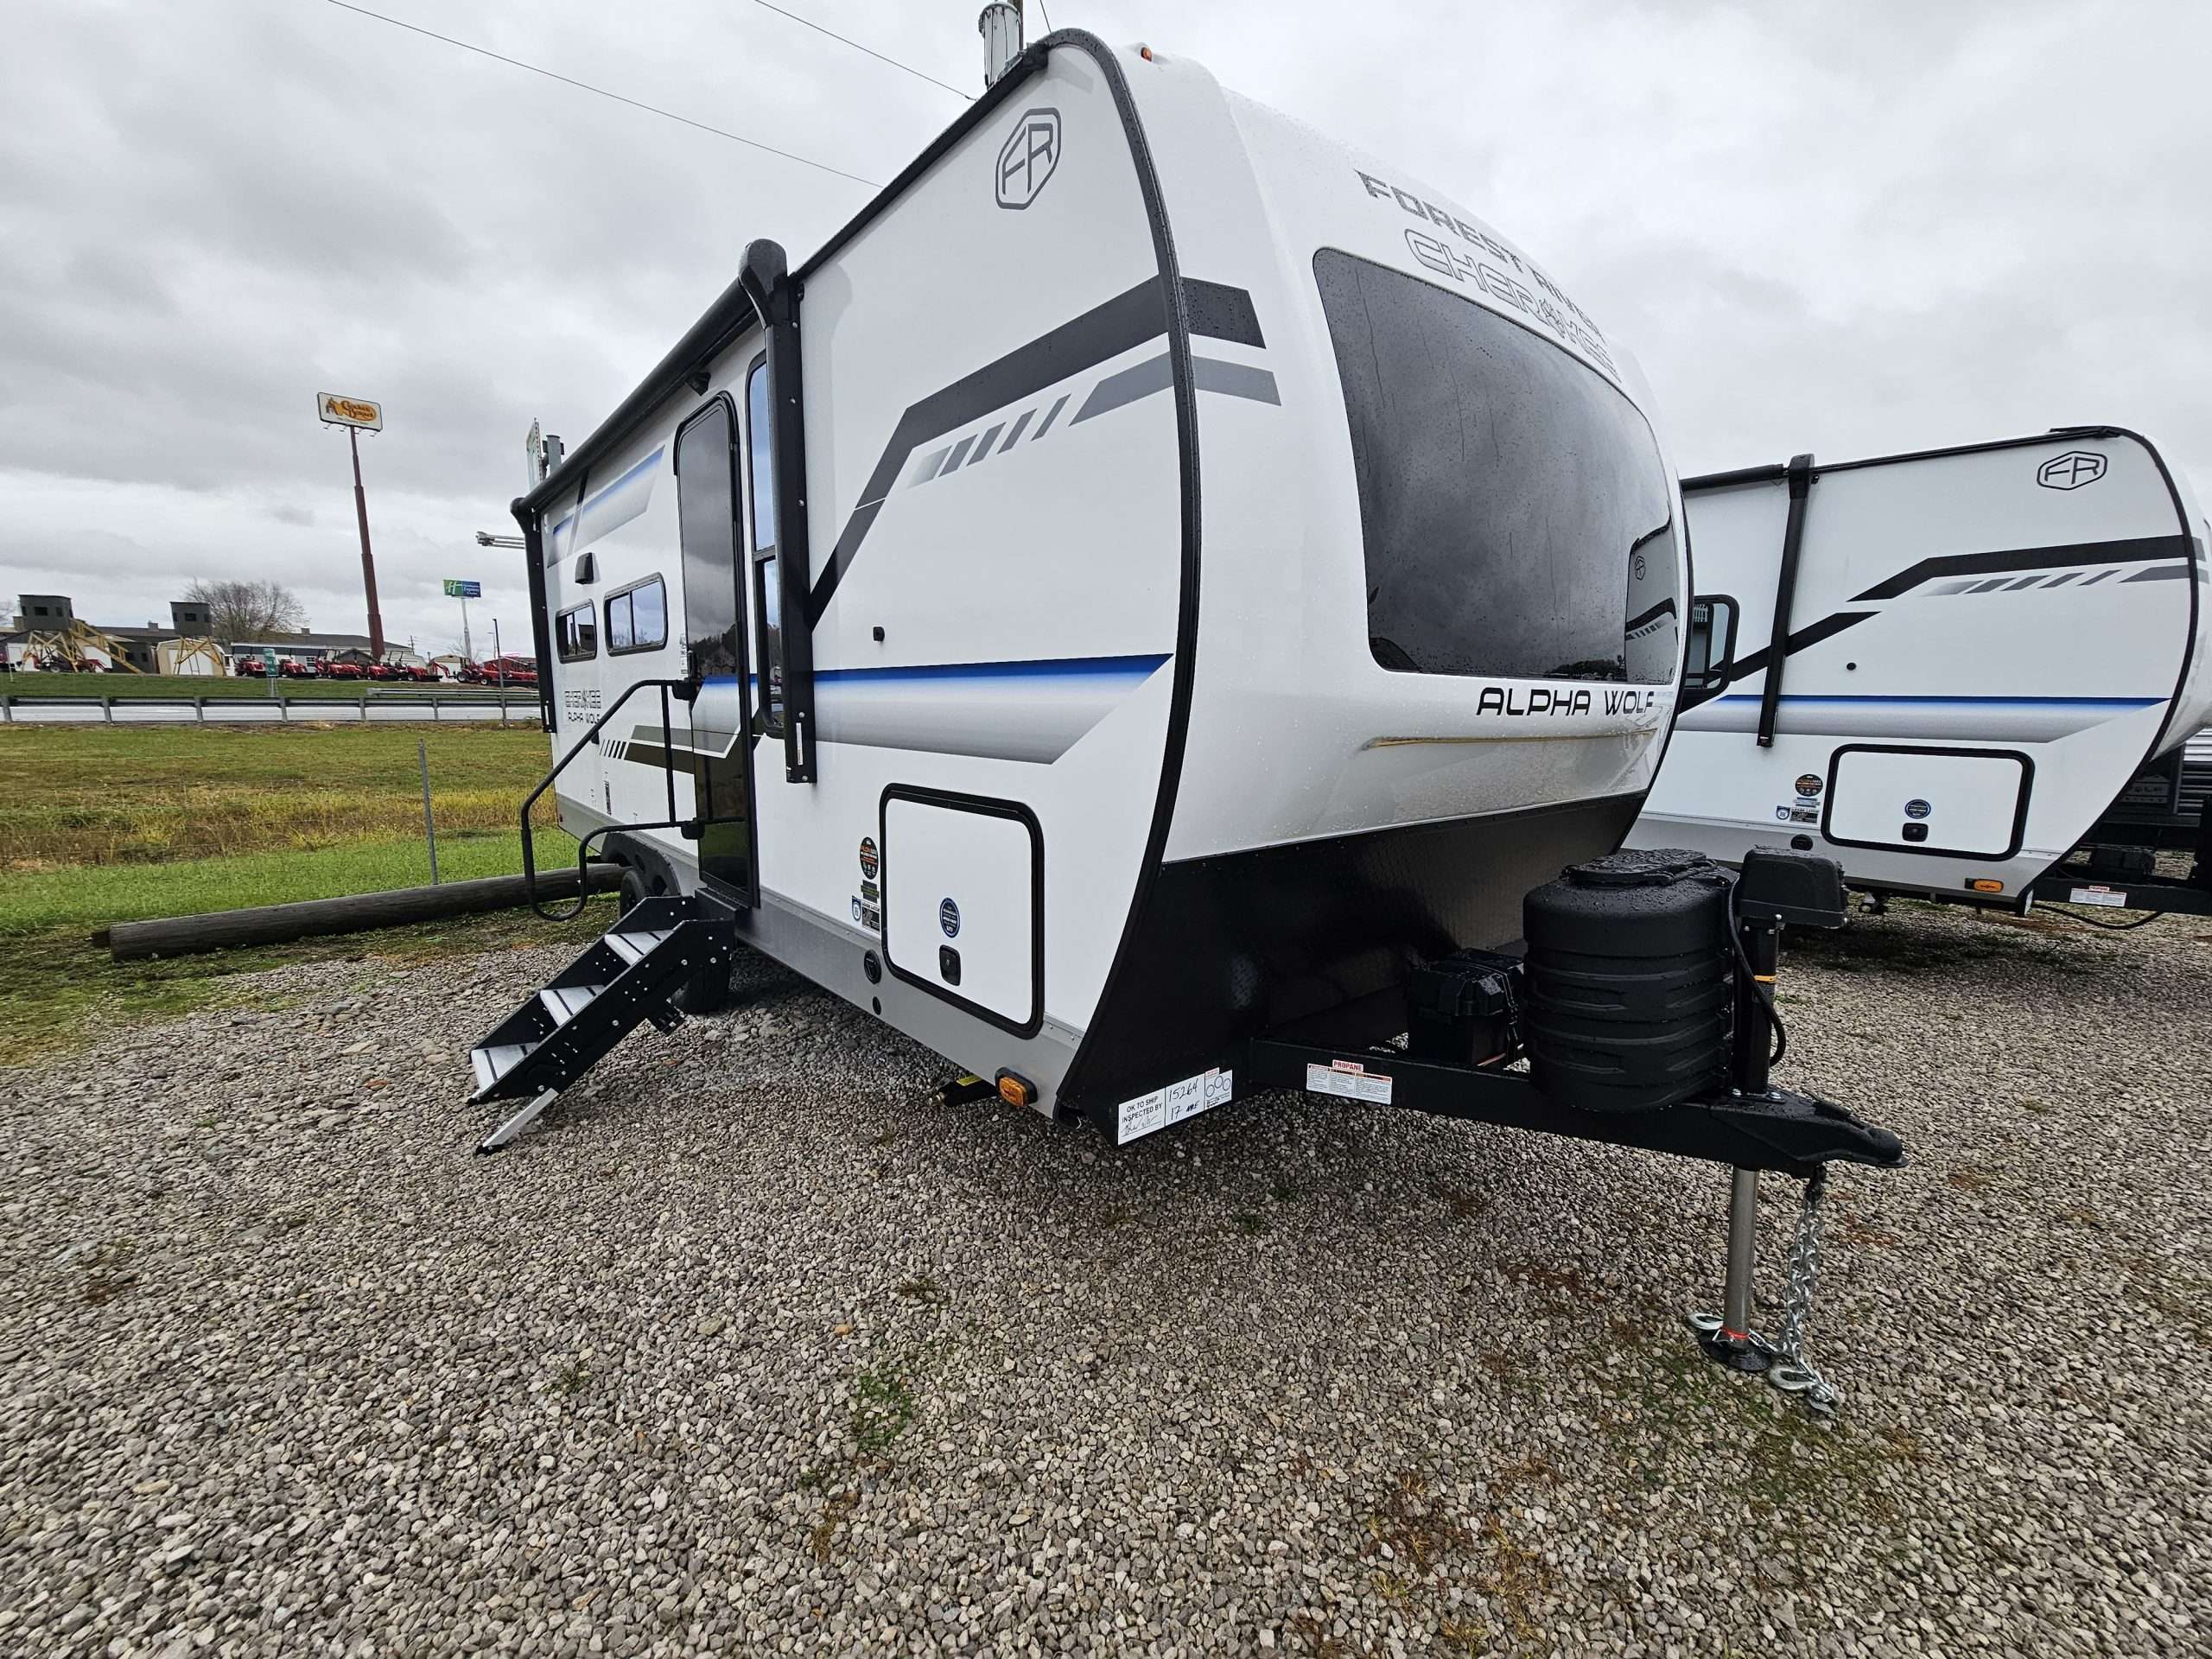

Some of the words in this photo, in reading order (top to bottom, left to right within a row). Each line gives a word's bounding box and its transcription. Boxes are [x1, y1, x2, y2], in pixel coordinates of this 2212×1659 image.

[1353, 168, 1522, 273] FOREST
[2044, 456, 2101, 485] FR
[1476, 687, 1591, 715] ALPHA
[1605, 690, 1655, 715] WOLF
[1333, 1061, 1362, 1071] PROPANE
[1169, 1078, 1198, 1102] 15264
[1122, 1106, 1154, 1123] INSPECTED
[1155, 1103, 1163, 1111] BY
[1127, 1104, 1135, 1113] OK
[1146, 1096, 1159, 1106] SHIP
